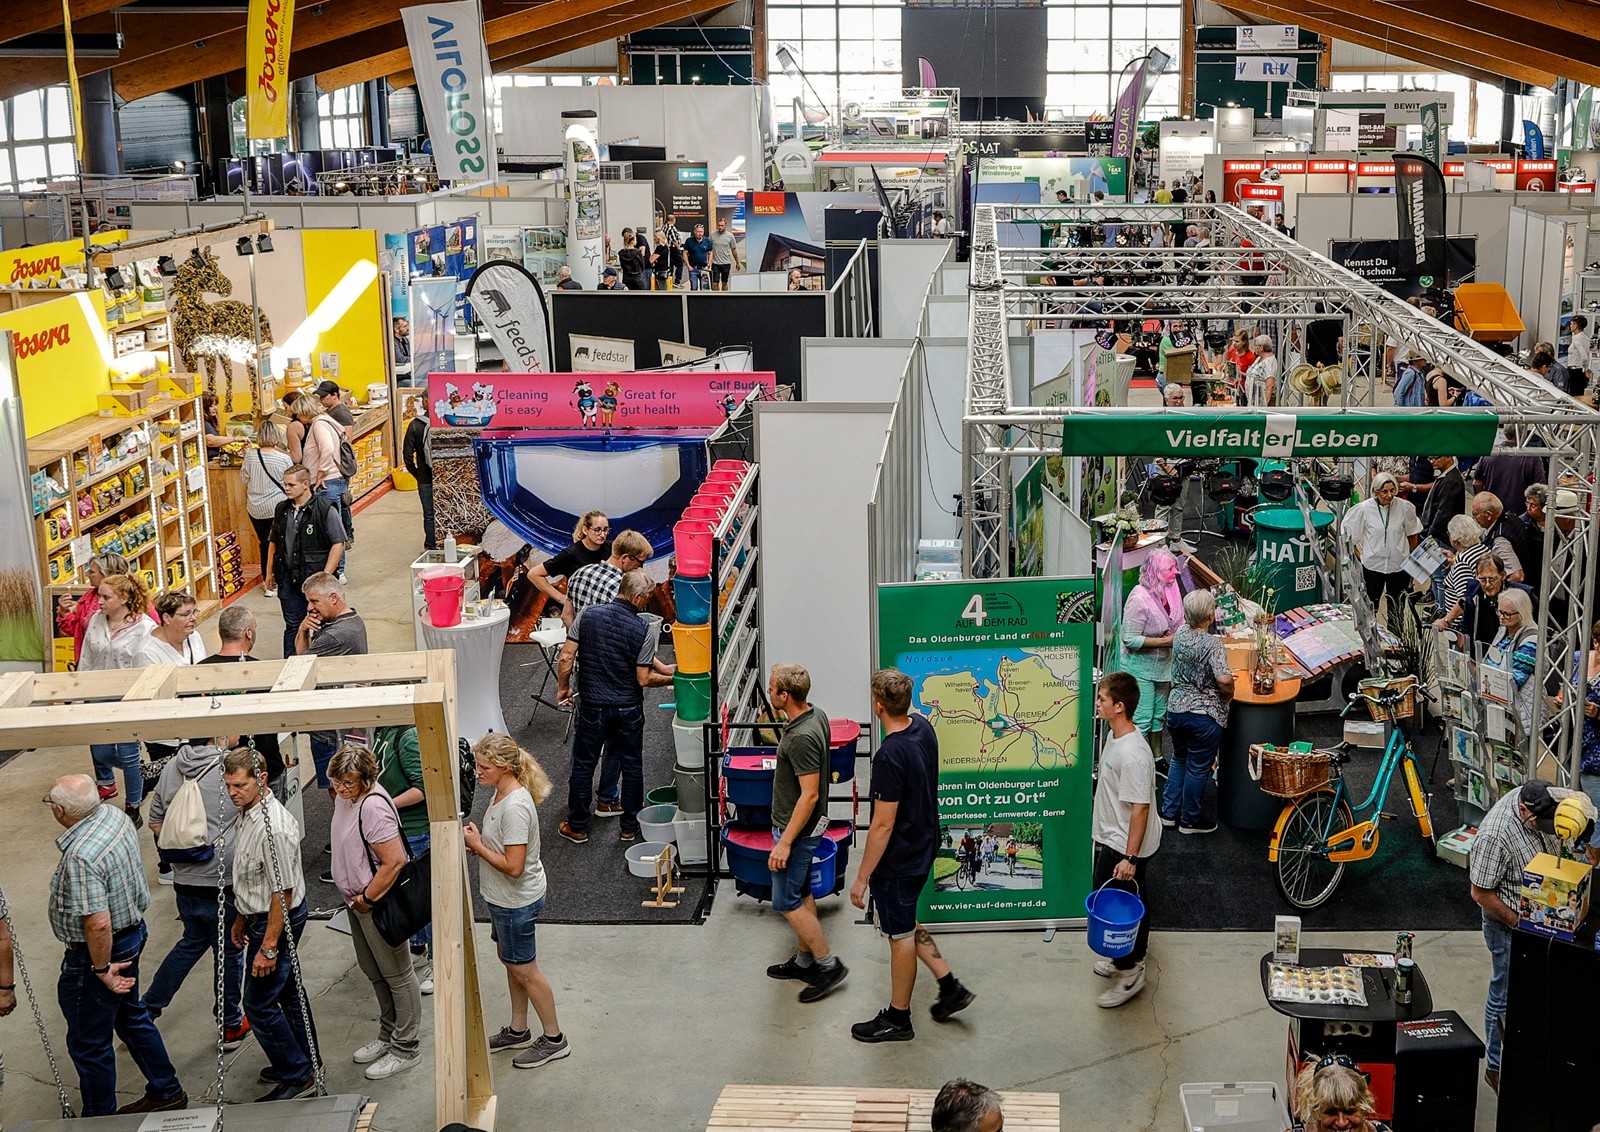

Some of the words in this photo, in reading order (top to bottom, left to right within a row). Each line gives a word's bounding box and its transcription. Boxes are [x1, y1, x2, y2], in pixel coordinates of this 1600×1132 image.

[1344, 259, 1373, 267] Kennst
[1375, 258, 1388, 266] Du
[11, 255, 61, 282] Josera
[1366, 267, 1396, 276] schon?
[591, 348, 629, 363] feedstar
[709, 381, 731, 390] Calf
[497, 389, 549, 402] Cleaning
[624, 389, 657, 400] Great
[660, 389, 677, 400] for
[505, 404, 513, 415] is
[516, 406, 542, 418] easy
[621, 405, 641, 417] gut
[644, 403, 680, 415] health
[961, 594, 988, 627] 4
[955, 619, 975, 629] AUF
[984, 618, 1005, 627] DEM
[1007, 617, 1028, 627] RAD
[908, 636, 927, 644] Das
[930, 633, 991, 643] Oldenburger
[994, 632, 1018, 641] Land
[905, 655, 954, 663] Nordsee
[1044, 652, 1081, 660] HOLSTEIN
[1015, 711, 1048, 719] BREMEN
[943, 757, 1008, 765] NIEDERSACHSEN
[965, 781, 976, 789] im
[978, 781, 1035, 790] Oldenburger
[1037, 779, 1059, 788] Land
[937, 796, 963, 806] von
[966, 793, 991, 805] Ort
[994, 795, 1011, 804] zu
[993, 810, 1037, 818] Lemwerder
[930, 900, 1047, 911] www.vier-auf-dem-rad.de
